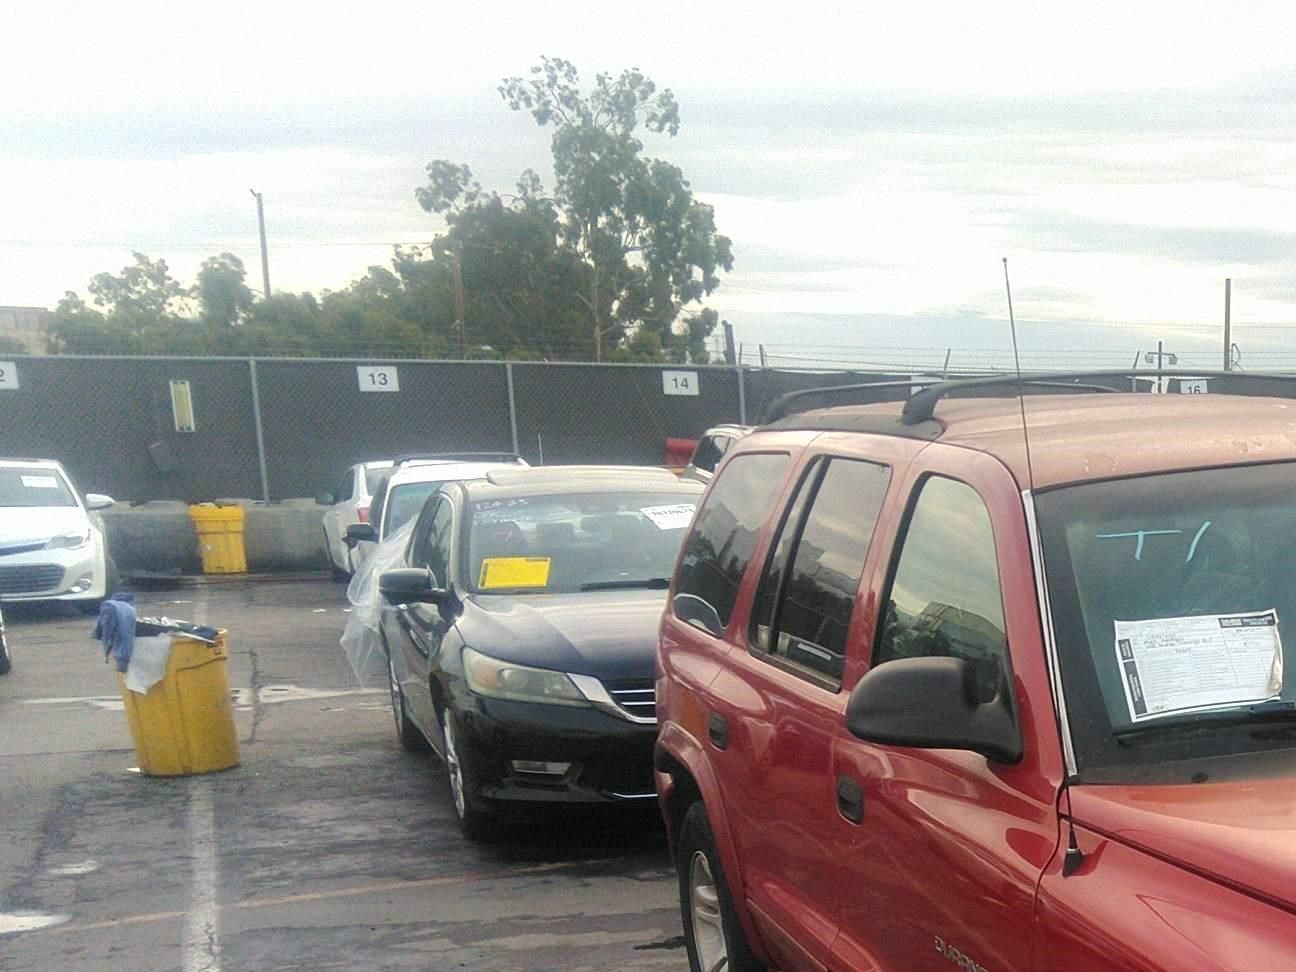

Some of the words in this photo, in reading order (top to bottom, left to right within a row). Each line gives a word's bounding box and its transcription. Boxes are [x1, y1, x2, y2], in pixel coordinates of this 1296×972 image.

[368, 372, 388, 386] 13
[671, 377, 689, 390] 14
[1187, 385, 1201, 394] 16
